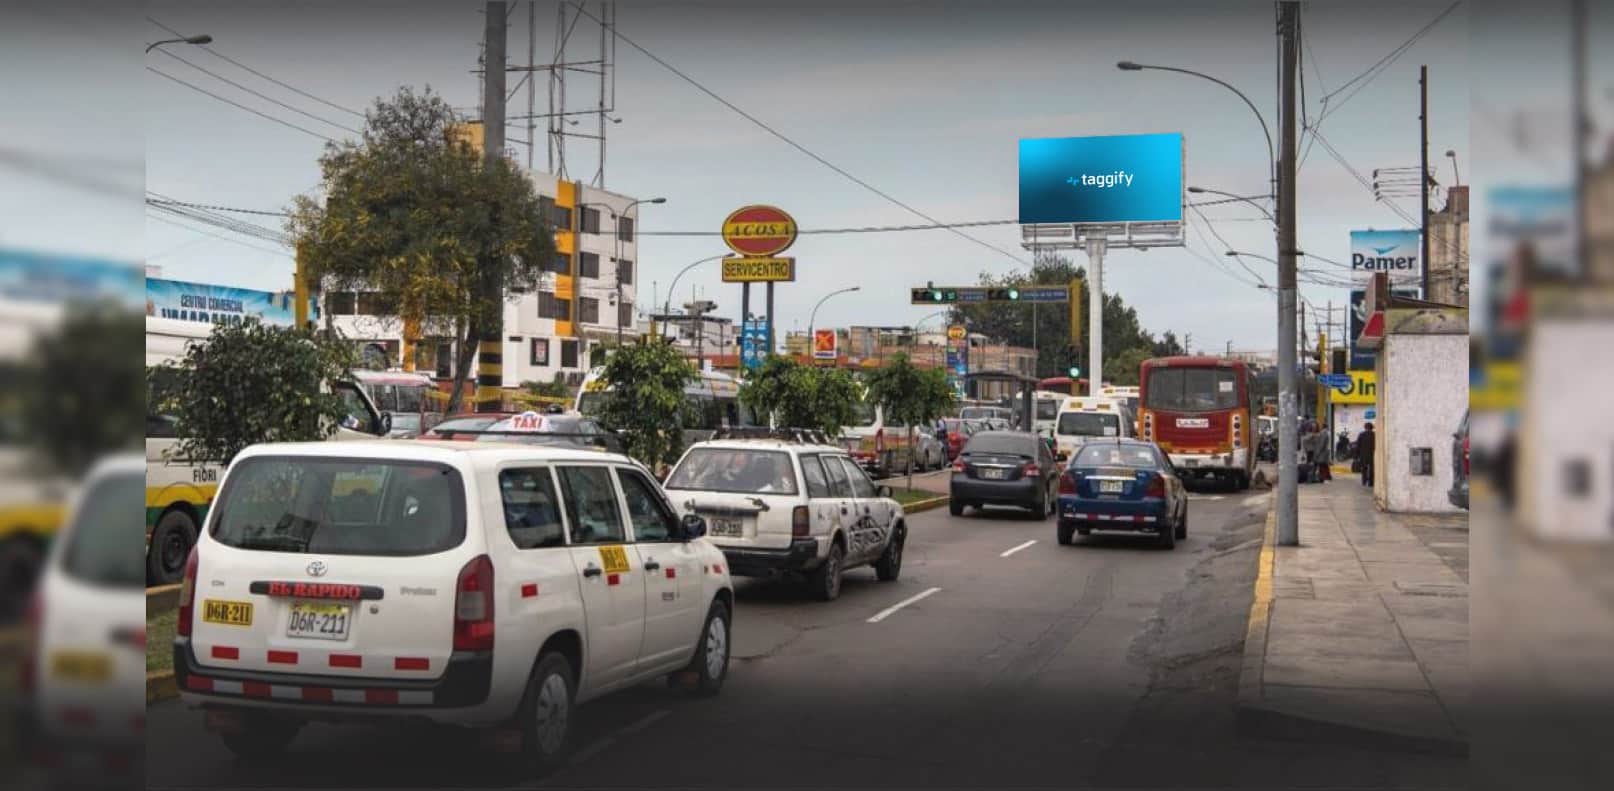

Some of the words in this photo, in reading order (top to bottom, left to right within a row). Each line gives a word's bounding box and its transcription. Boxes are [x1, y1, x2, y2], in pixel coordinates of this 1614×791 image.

[1081, 171, 1134, 188] taggify
[725, 262, 787, 277] SERVICENTRO
[1352, 253, 1416, 270] Pamer
[181, 294, 207, 309] CENTRO
[209, 298, 243, 313] COMERCIAL
[515, 416, 543, 429] TAXI
[193, 469, 217, 482] FIORI
[271, 582, 289, 596] EL
[295, 583, 361, 599] RAPIDO
[206, 603, 250, 622] D6R-211
[291, 610, 345, 634] D6R-211
